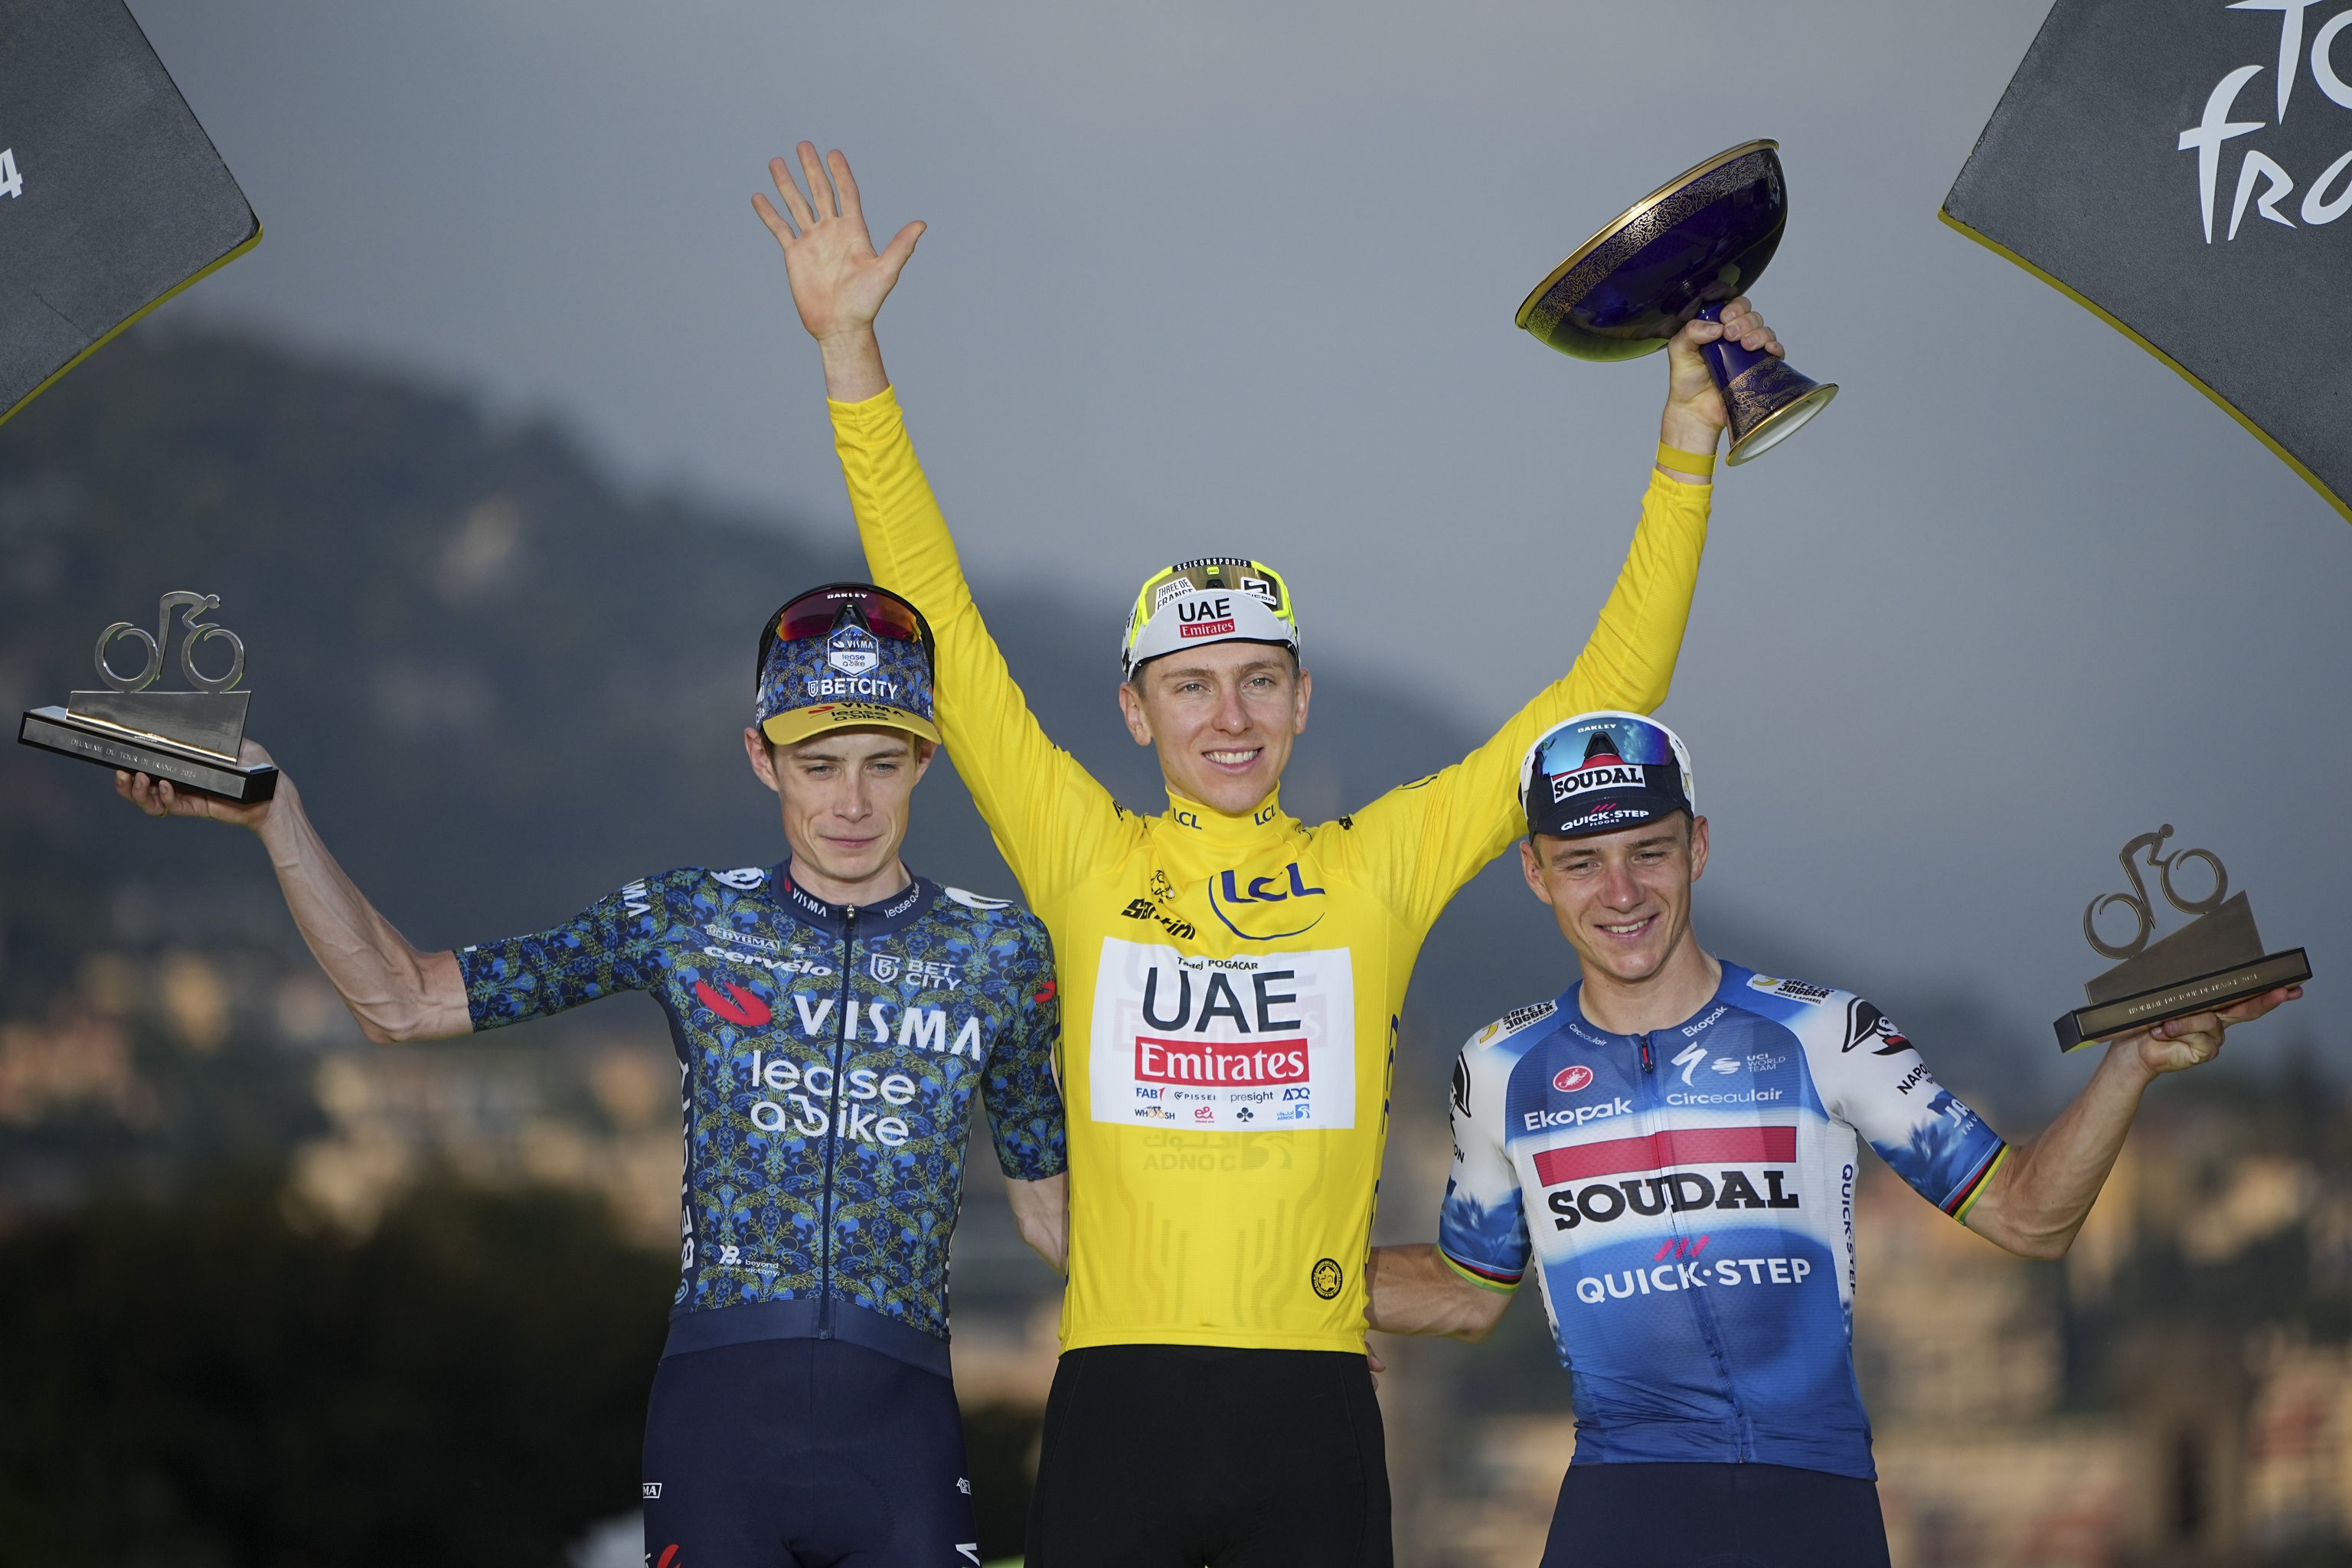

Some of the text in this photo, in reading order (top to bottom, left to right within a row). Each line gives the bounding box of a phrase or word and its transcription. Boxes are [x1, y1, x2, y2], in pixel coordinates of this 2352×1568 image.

[1158, 579, 1191, 599] THREE DE
[1178, 597, 1231, 622] UAE
[1182, 620, 1233, 636] Emirates
[848, 640, 873, 648] VISMA
[821, 678, 898, 700] BETCITY
[841, 703, 905, 718] VISMA
[1578, 724, 1616, 733] OAKLEY
[106, 748, 116, 756] DU
[119, 752, 138, 763] TOUR
[140, 757, 149, 766] DE
[152, 761, 178, 773] FRANCE
[181, 769, 197, 779] 2024
[1554, 767, 1643, 799] SOUDAL
[1173, 807, 1202, 830] LCL
[1254, 804, 1276, 826] LCL
[1589, 818, 1620, 827] FLOORS
[1220, 862, 1326, 903] LCL
[792, 888, 827, 917] VISMA
[884, 900, 912, 919] lease
[722, 930, 776, 949] BYGMA
[704, 946, 832, 976] cervélo
[907, 959, 956, 976] BET
[1208, 959, 1258, 970] POGACAR
[906, 972, 962, 991] CITY
[1777, 985, 1829, 998] JOGGER
[1142, 967, 1301, 1034] UAE
[1798, 996, 1821, 1004] APPAREL
[1503, 1001, 1552, 1023] SAFETY
[1504, 1004, 1553, 1030] JOGGER
[1681, 1006, 1728, 1037] Ekopak
[793, 994, 981, 1062] VISMA
[1508, 1024, 1527, 1034] SHOES
[1570, 1024, 1607, 1047] Circeaulair
[1140, 1042, 1304, 1082] Emirates
[1746, 1053, 1769, 1061] UCI
[1747, 1057, 1785, 1067] WORLD
[751, 1049, 916, 1106] lease
[1748, 1064, 1776, 1073] TEAM
[1896, 1062, 1930, 1096] NAPO
[1136, 1087, 1158, 1099] FAB
[1230, 1091, 1273, 1104] presight
[1282, 1086, 1310, 1101] ADQ
[1666, 1088, 1783, 1106] Circeaulair
[1524, 1097, 1634, 1131] Ekopak
[1547, 1170, 1800, 1231] SOUDAL
[745, 1259, 779, 1269] beyond
